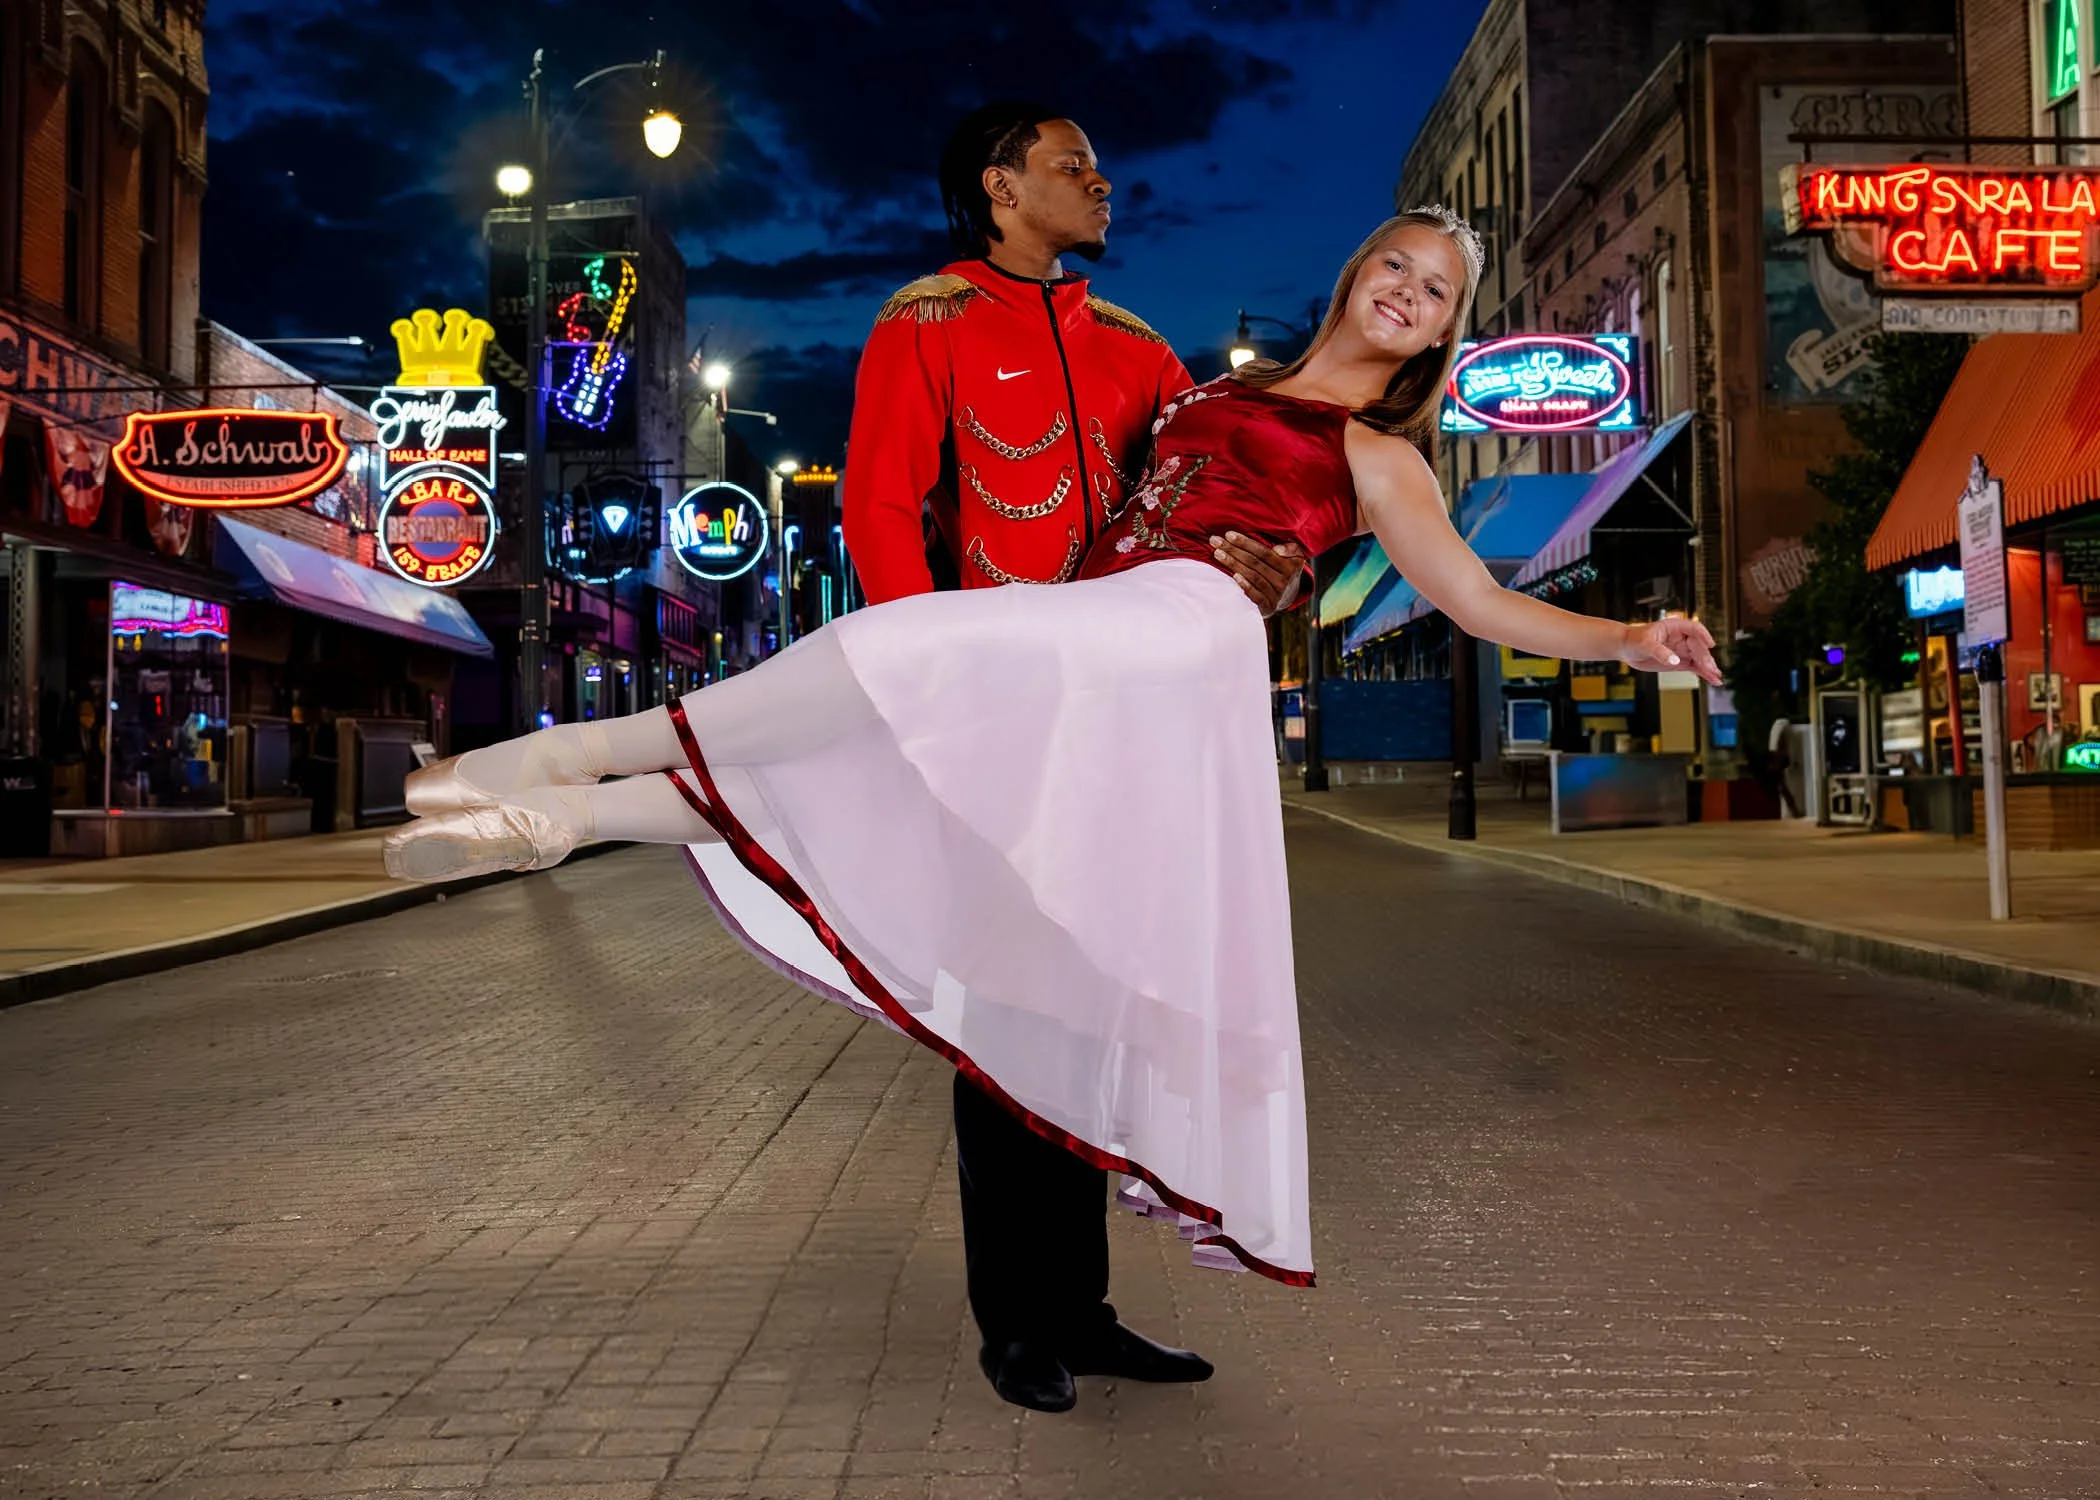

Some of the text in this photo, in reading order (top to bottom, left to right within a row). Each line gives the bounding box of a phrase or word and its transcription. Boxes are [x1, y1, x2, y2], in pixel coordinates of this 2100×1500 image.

[1892, 228, 2082, 272] CAFE
[175, 420, 333, 467] Schwab
[389, 450, 425, 462] HALL
[387, 515, 489, 544] RESTAURANT
[393, 547, 421, 572] 159
